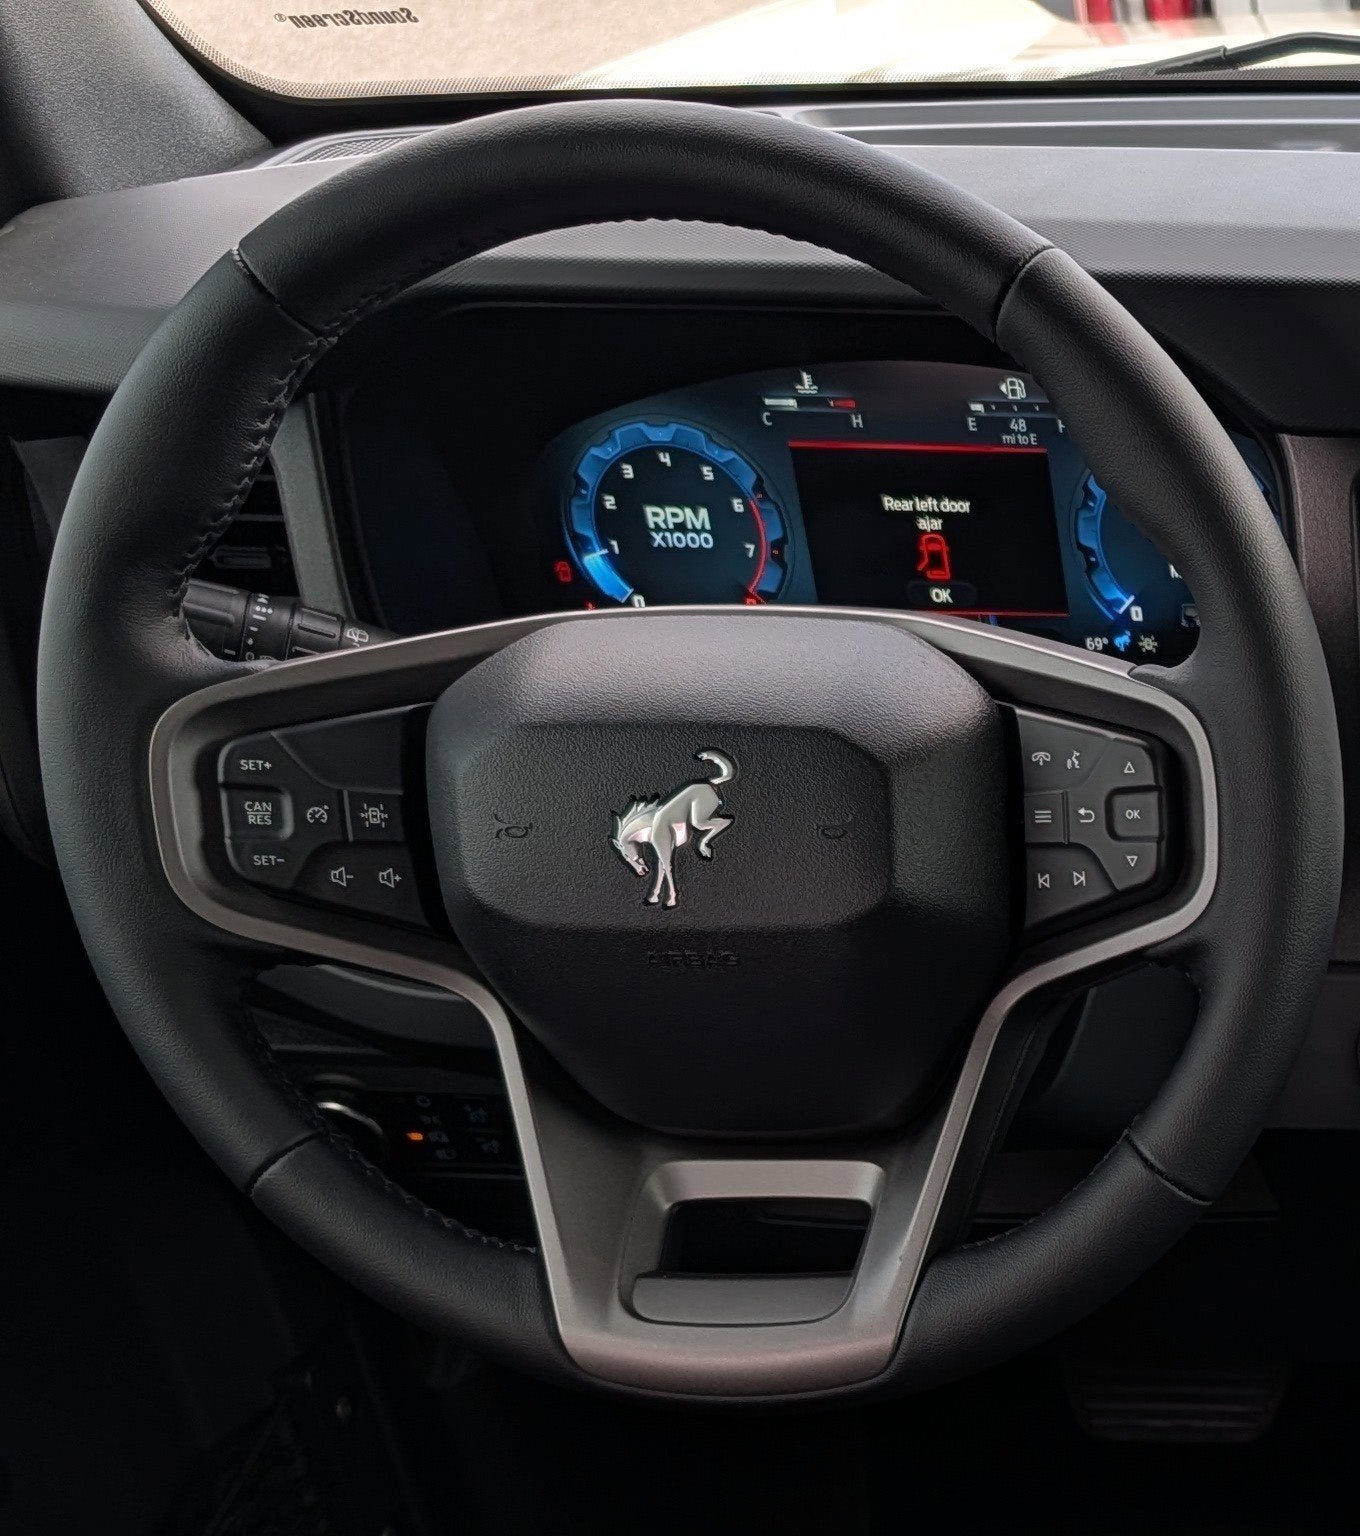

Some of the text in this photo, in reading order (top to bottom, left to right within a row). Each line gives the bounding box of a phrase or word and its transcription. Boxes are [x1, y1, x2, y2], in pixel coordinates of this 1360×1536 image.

[761, 412, 773, 426] C
[852, 414, 864, 429] H
[967, 416, 977, 432] E
[1009, 418, 1027, 433] 48
[656, 451, 672, 468] 4
[620, 462, 635, 480] 3
[701, 464, 715, 481] 5
[602, 494, 618, 510] 2
[731, 498, 745, 514] 6
[881, 494, 971, 513] Rear left door
[644, 505, 712, 531] RPM
[916, 516, 943, 532] ajar
[650, 531, 714, 549] X1000
[744, 541, 756, 558] 7
[930, 587, 953, 604] OK
[239, 759, 272, 771] SET+
[244, 801, 272, 813] CAN
[1125, 809, 1141, 820] OK
[248, 814, 272, 826] RES
